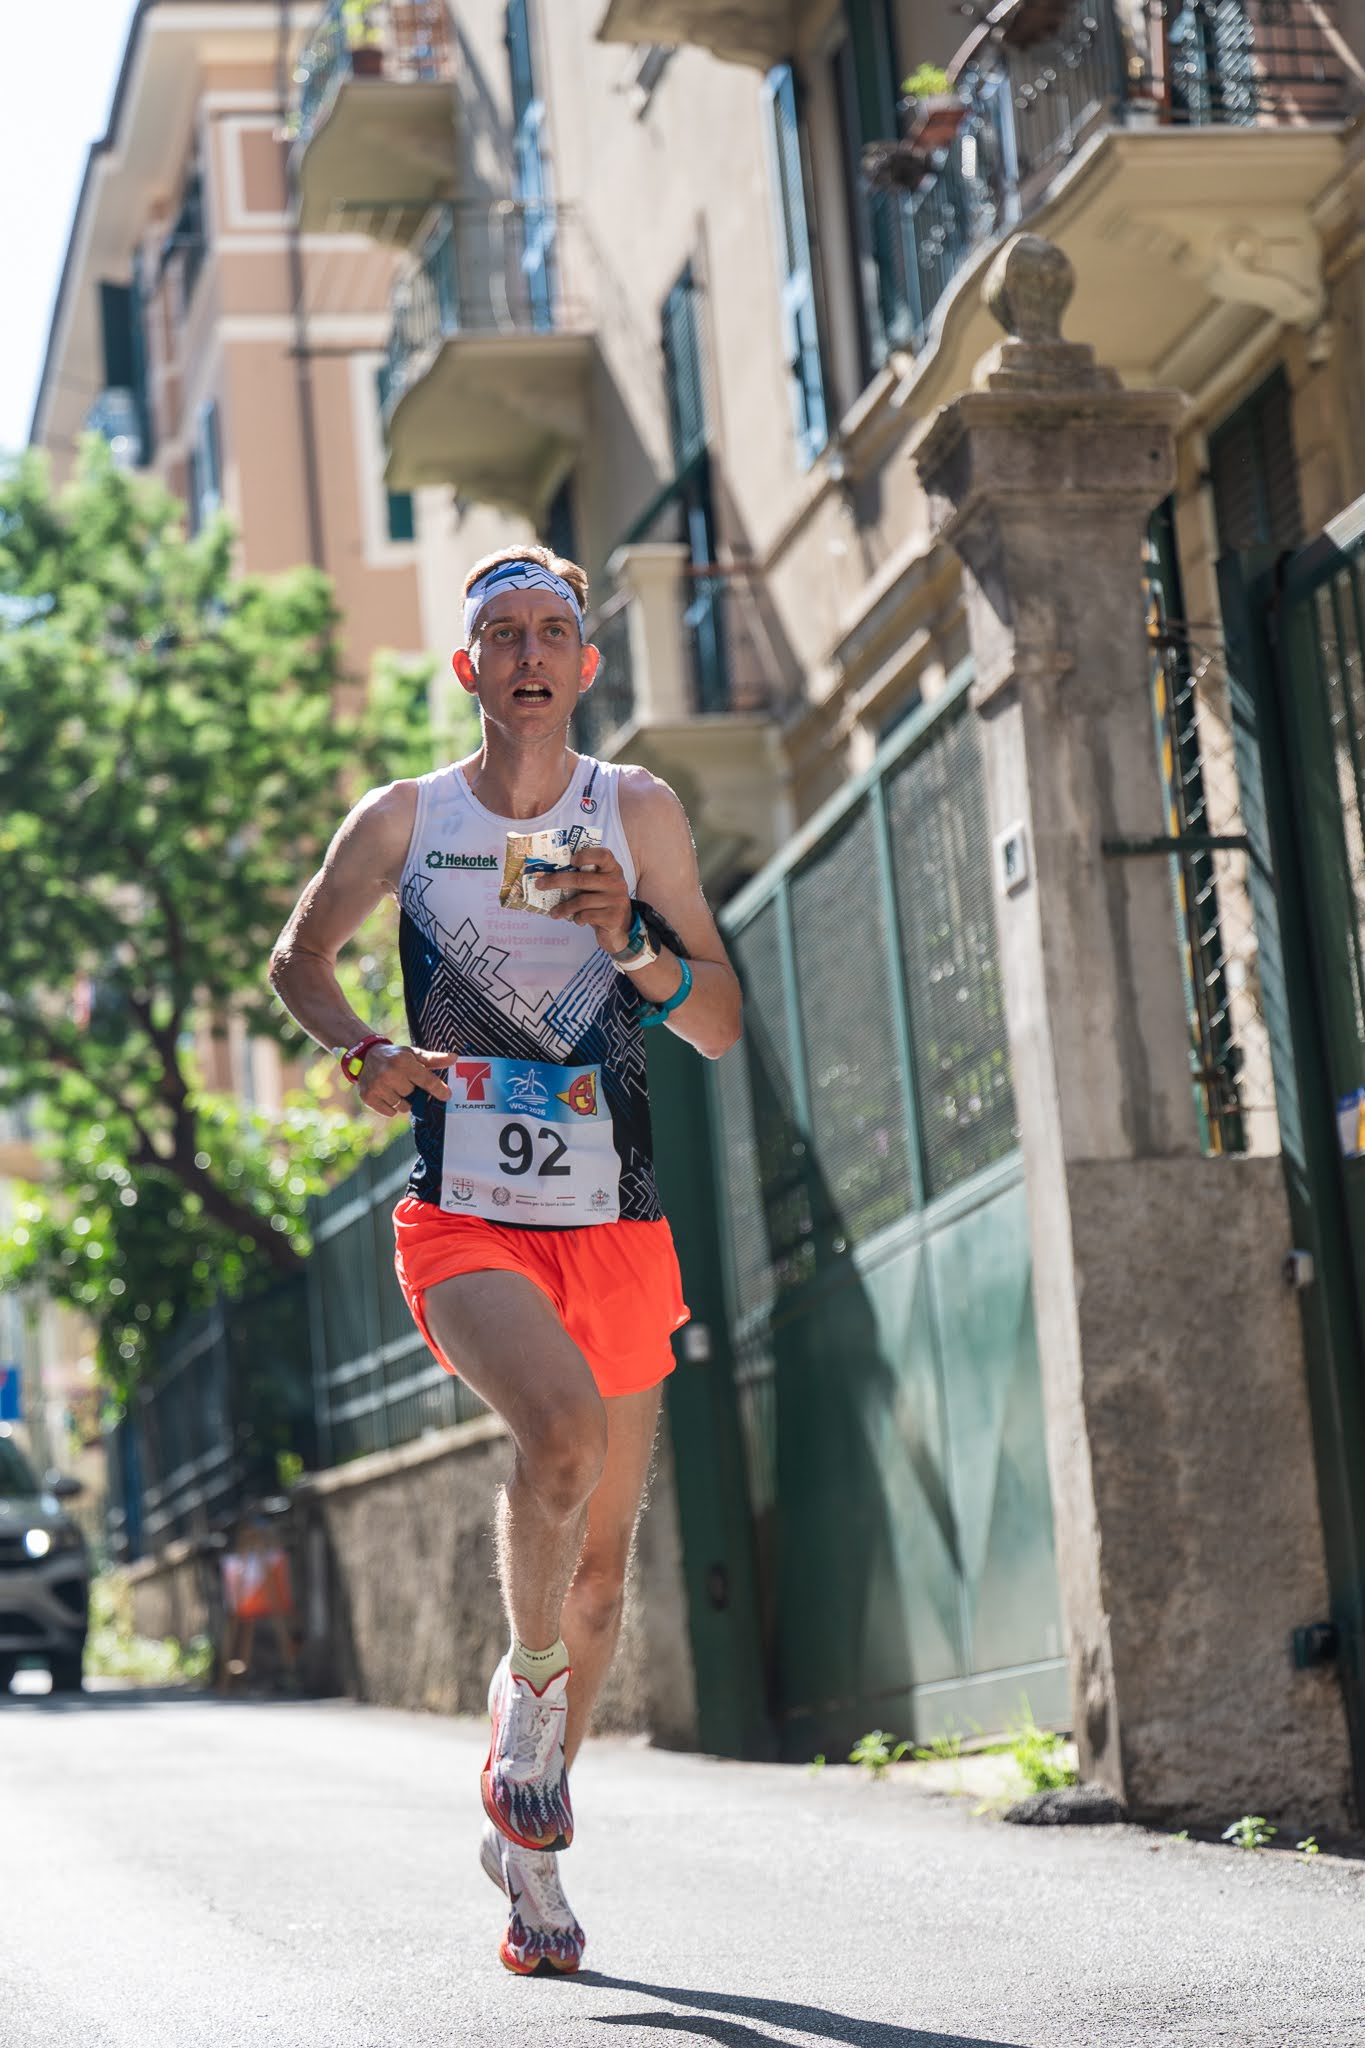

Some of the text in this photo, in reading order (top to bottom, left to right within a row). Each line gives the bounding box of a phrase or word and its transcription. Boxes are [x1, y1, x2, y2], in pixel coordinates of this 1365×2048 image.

[445, 853, 498, 867] Hekotek
[509, 1102, 546, 1116] WOC 2026
[498, 1122, 571, 1177] 92
